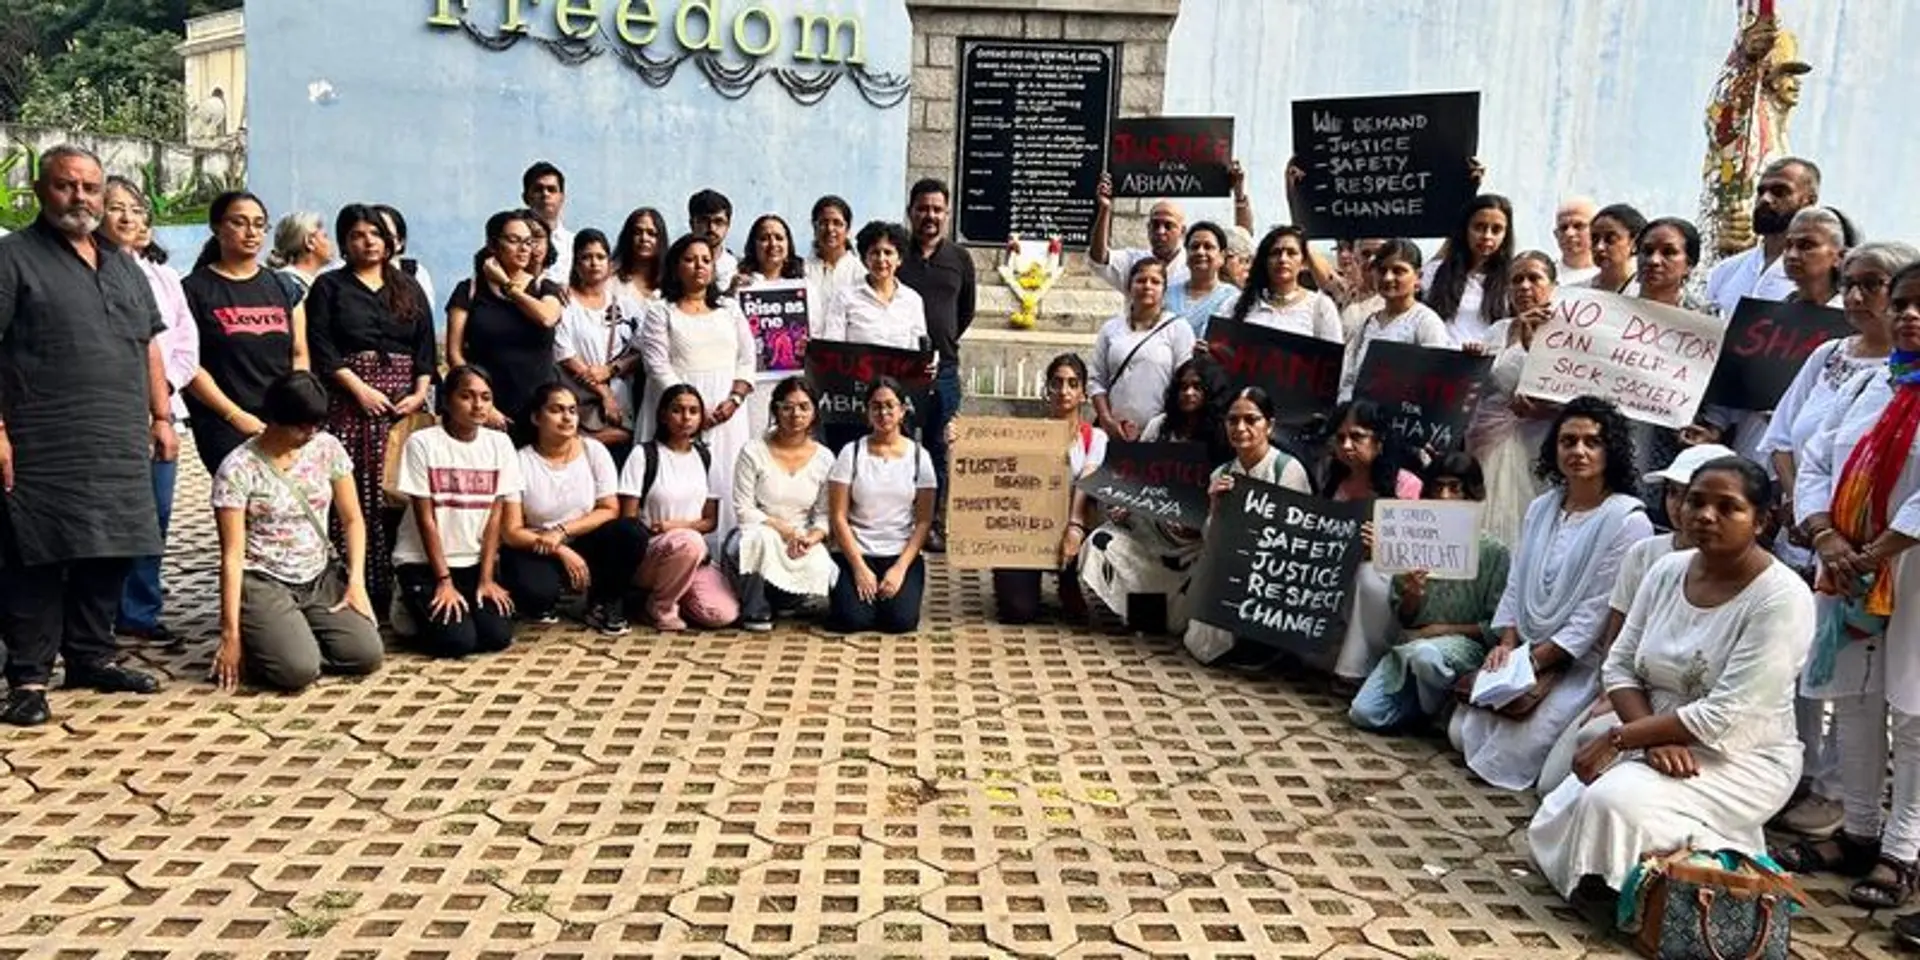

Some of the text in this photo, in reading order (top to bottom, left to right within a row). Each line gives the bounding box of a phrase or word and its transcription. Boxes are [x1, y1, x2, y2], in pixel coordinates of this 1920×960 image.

[1353, 115, 1428, 133] DEMAND
[1121, 173, 1202, 193] ABHAYA
[744, 298, 805, 315] Rise as
[1551, 299, 1716, 361] NO DOCTOR
[1735, 320, 1828, 359] SHA
[1546, 331, 1688, 381] CAN HELP A
[1553, 357, 1691, 406] SICK SOCIETY
[818, 391, 916, 414] ABHA
[1392, 416, 1450, 446] HAYA
[1244, 489, 1278, 519] WE
